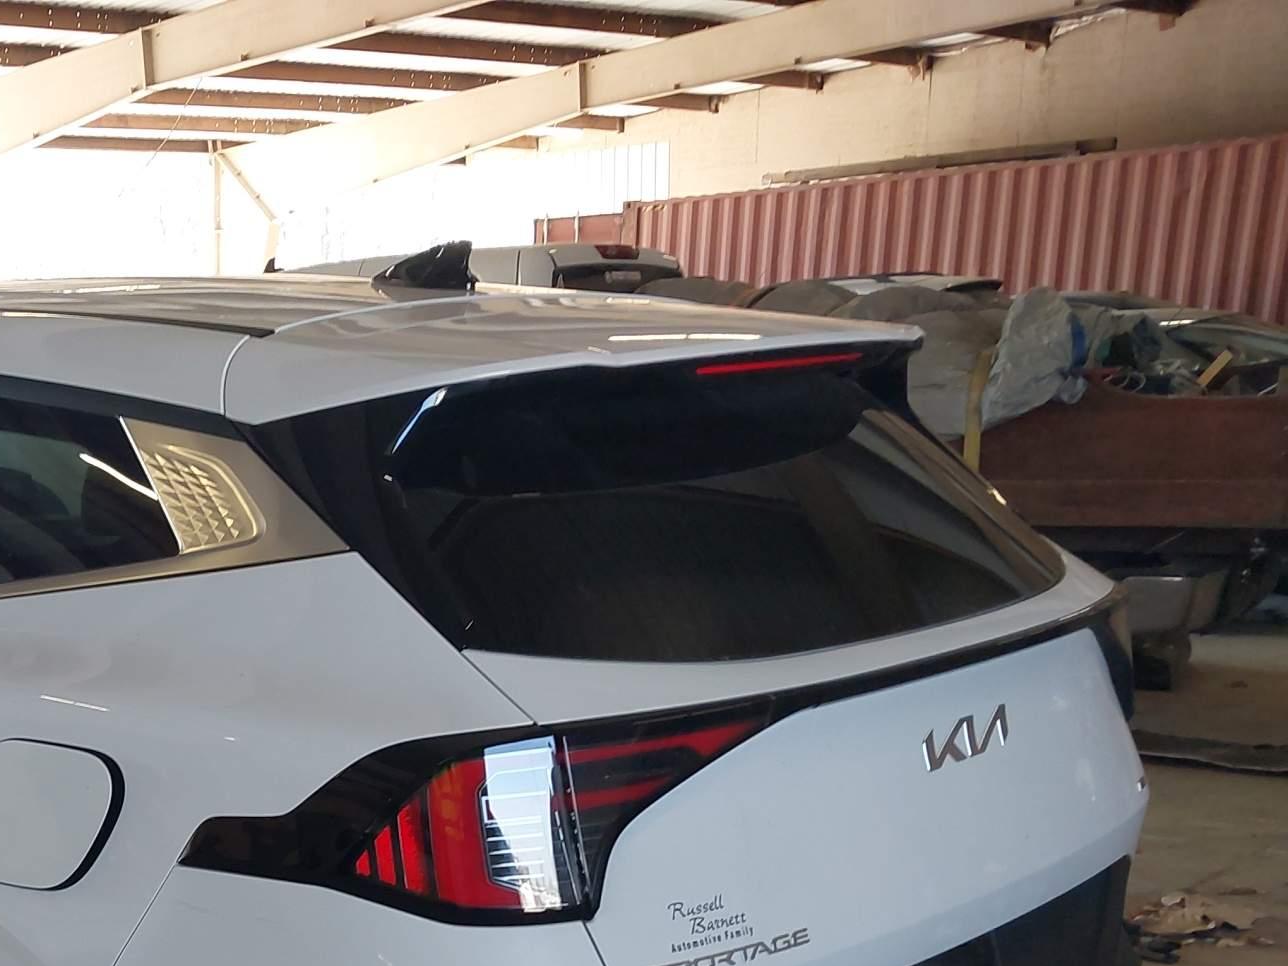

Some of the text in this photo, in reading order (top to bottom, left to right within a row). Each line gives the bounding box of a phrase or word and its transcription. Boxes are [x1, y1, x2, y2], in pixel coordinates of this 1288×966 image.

[922, 704, 1008, 772] KIA
[667, 894, 724, 920] Russell
[689, 913, 746, 934] Barnett
[672, 926, 754, 953] Automotive Family
